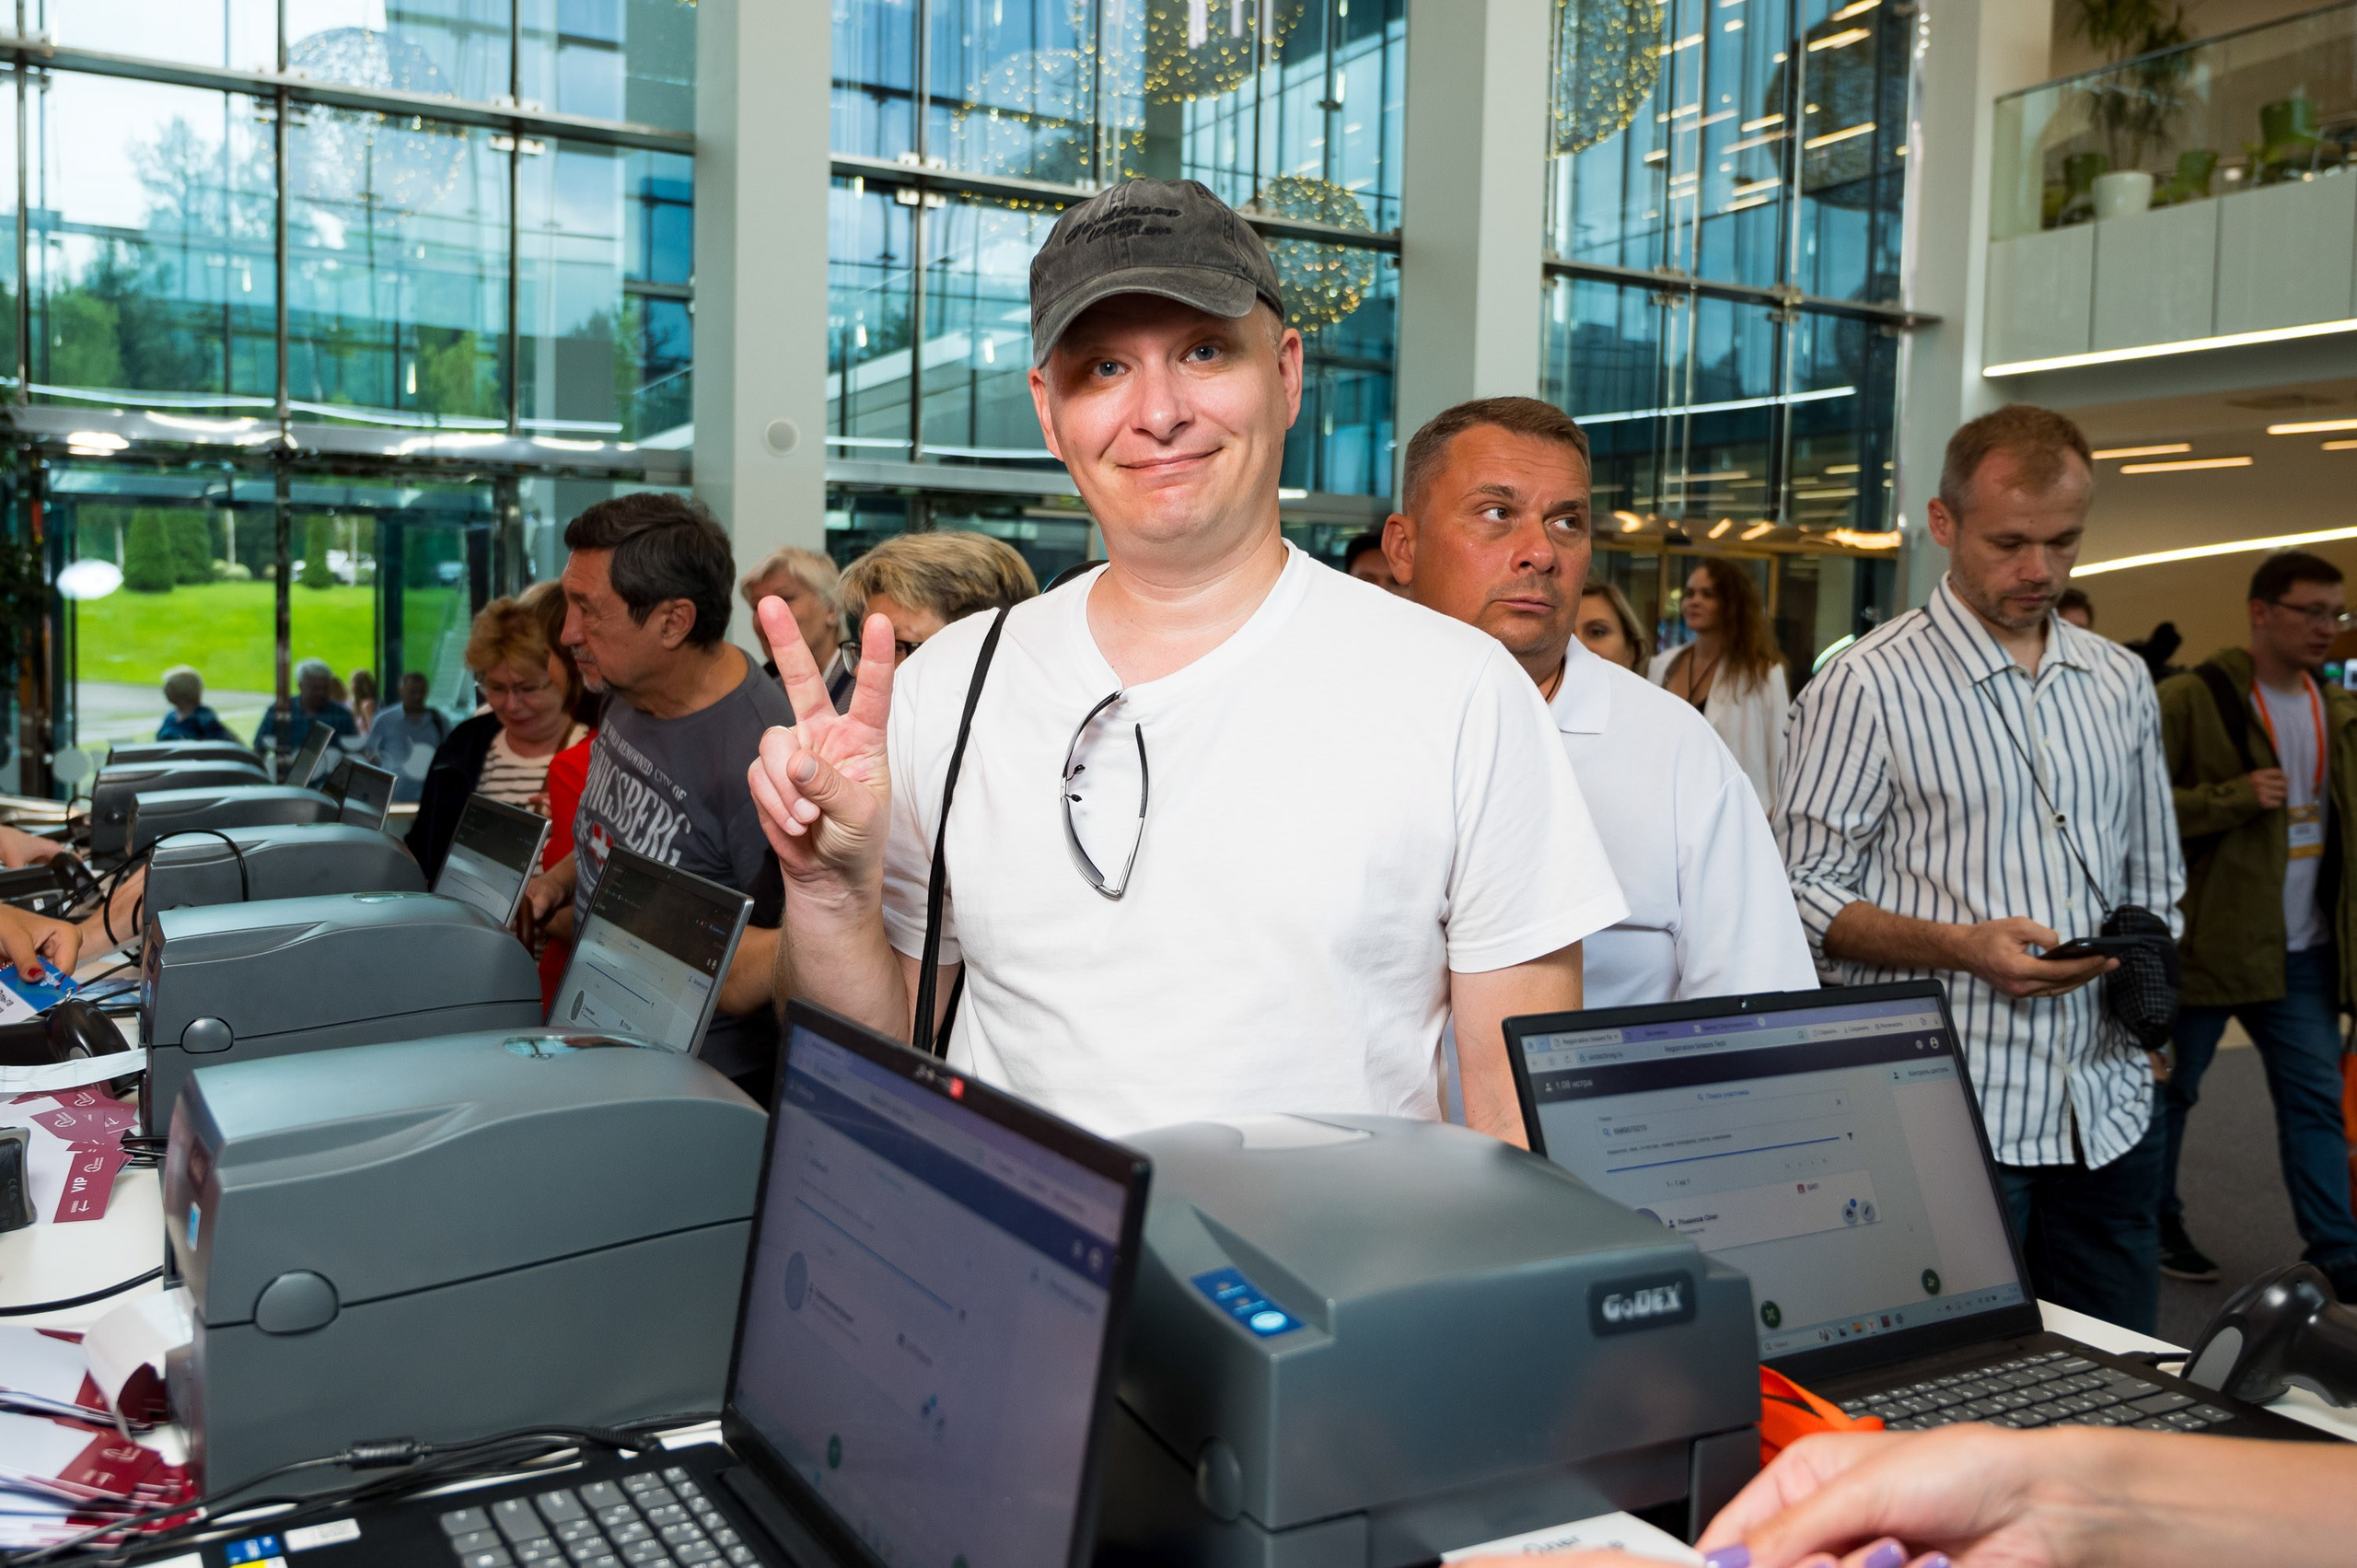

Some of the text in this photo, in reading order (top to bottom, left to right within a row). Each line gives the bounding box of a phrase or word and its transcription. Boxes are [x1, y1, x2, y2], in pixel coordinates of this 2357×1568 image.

[618, 738, 655, 777] RENOWNED
[654, 767, 673, 788] CITY
[672, 784, 688, 802] OF
[71, 1177, 89, 1193] VIP
